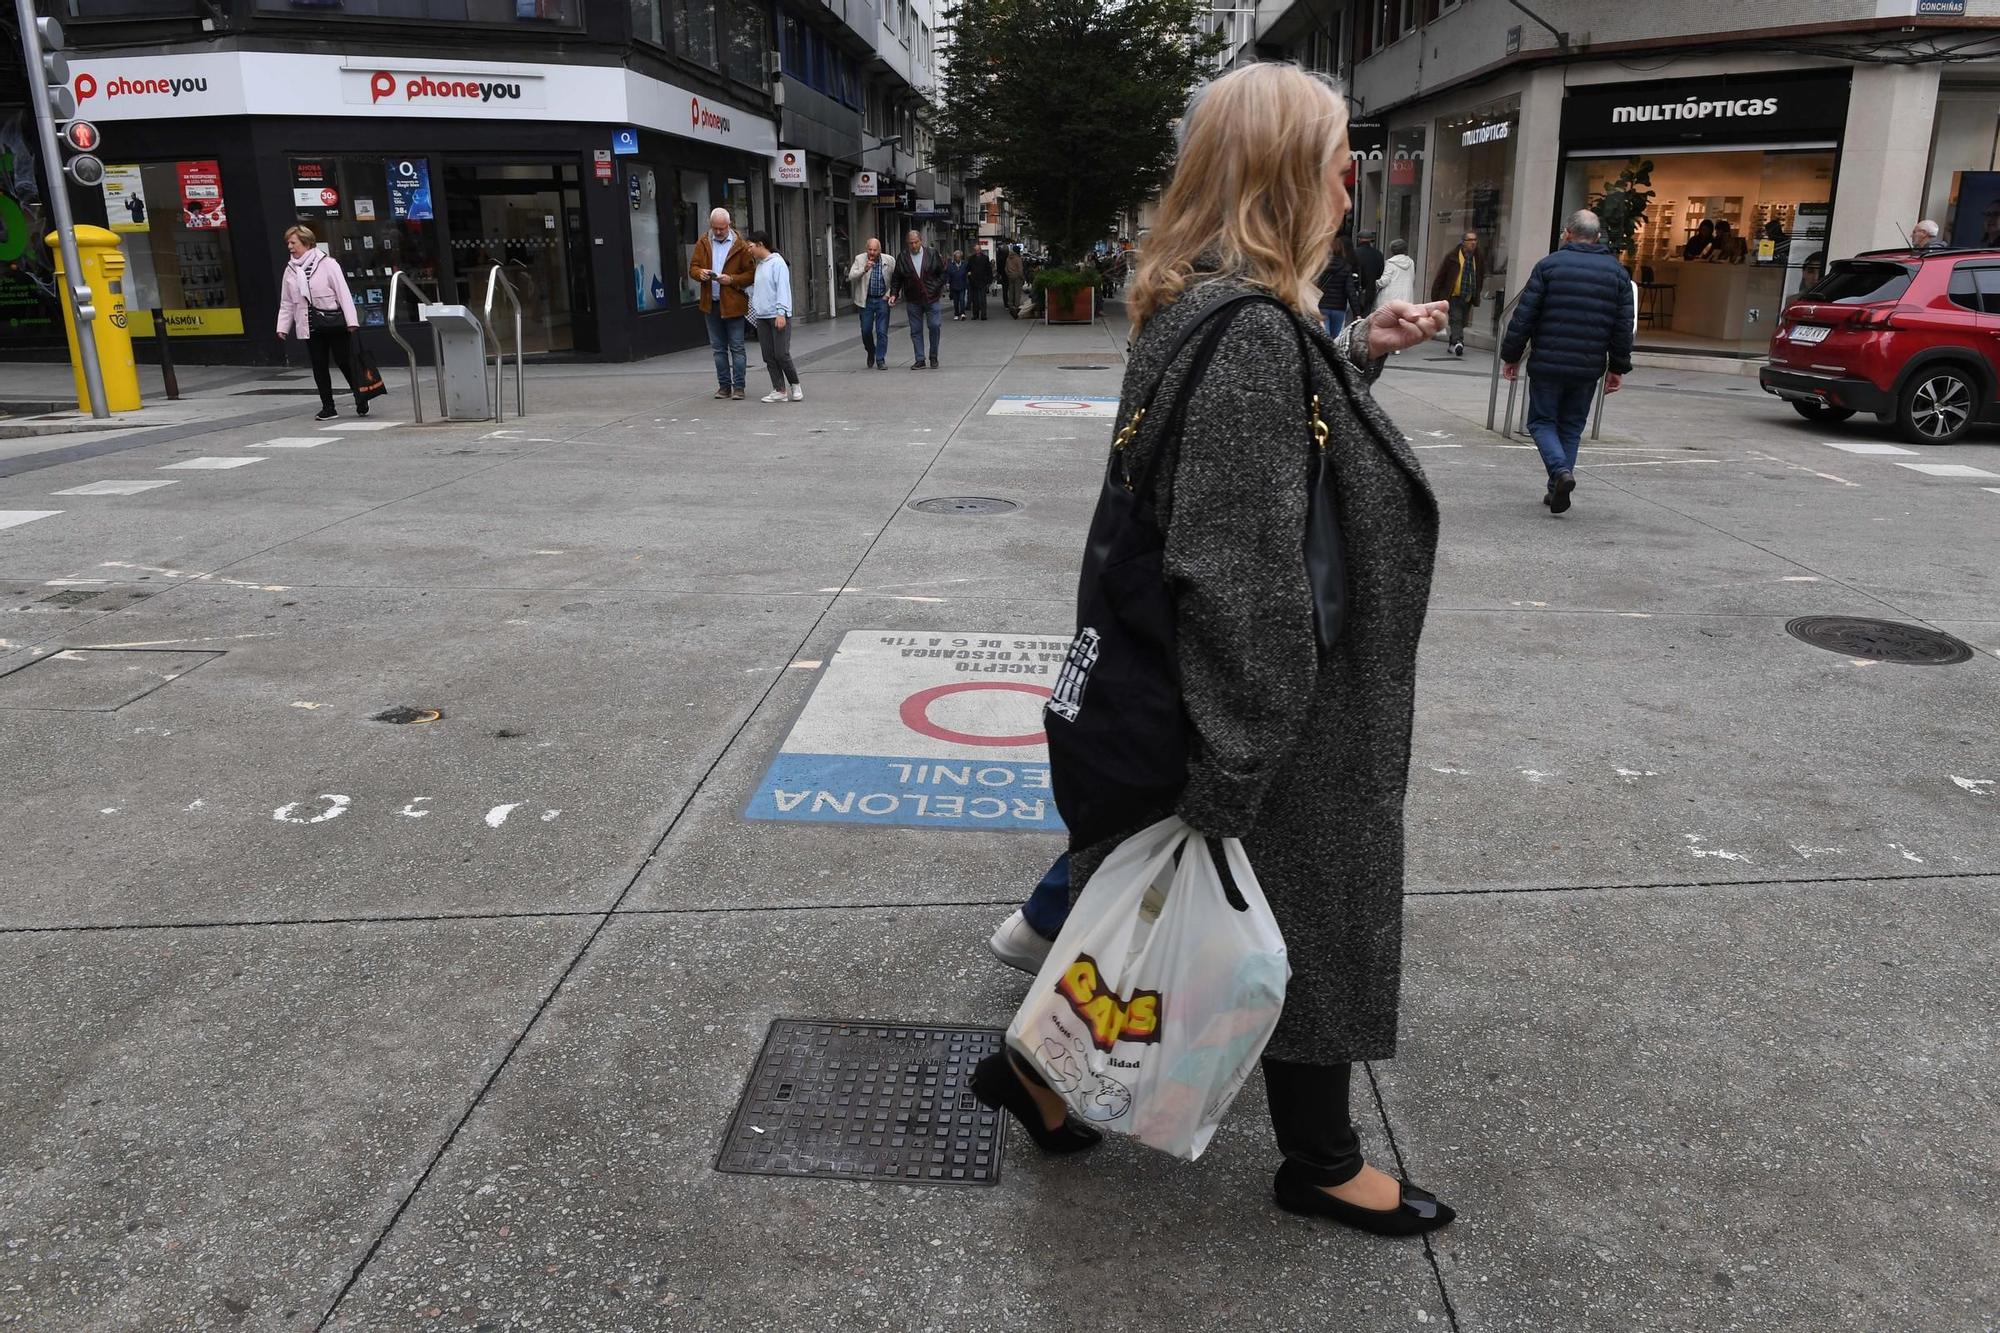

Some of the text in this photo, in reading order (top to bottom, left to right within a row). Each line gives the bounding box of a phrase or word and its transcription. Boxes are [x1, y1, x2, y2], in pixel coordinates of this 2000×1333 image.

[1920, 2, 1963, 11] CONCHIÑAS
[106, 75, 208, 101] phoneyou
[406, 75, 521, 103] phoneyou
[701, 107, 731, 135] phoneyou
[929, 637, 942, 647] A
[951, 638, 970, 648] 6
[977, 638, 1002, 649] DE
[901, 648, 1013, 662] DESCARGA
[1018, 651, 1031, 662] Y
[955, 661, 1048, 675] EXCEPTO
[888, 763, 1051, 789] EONIL
[774, 788, 1056, 820] RCELONA
